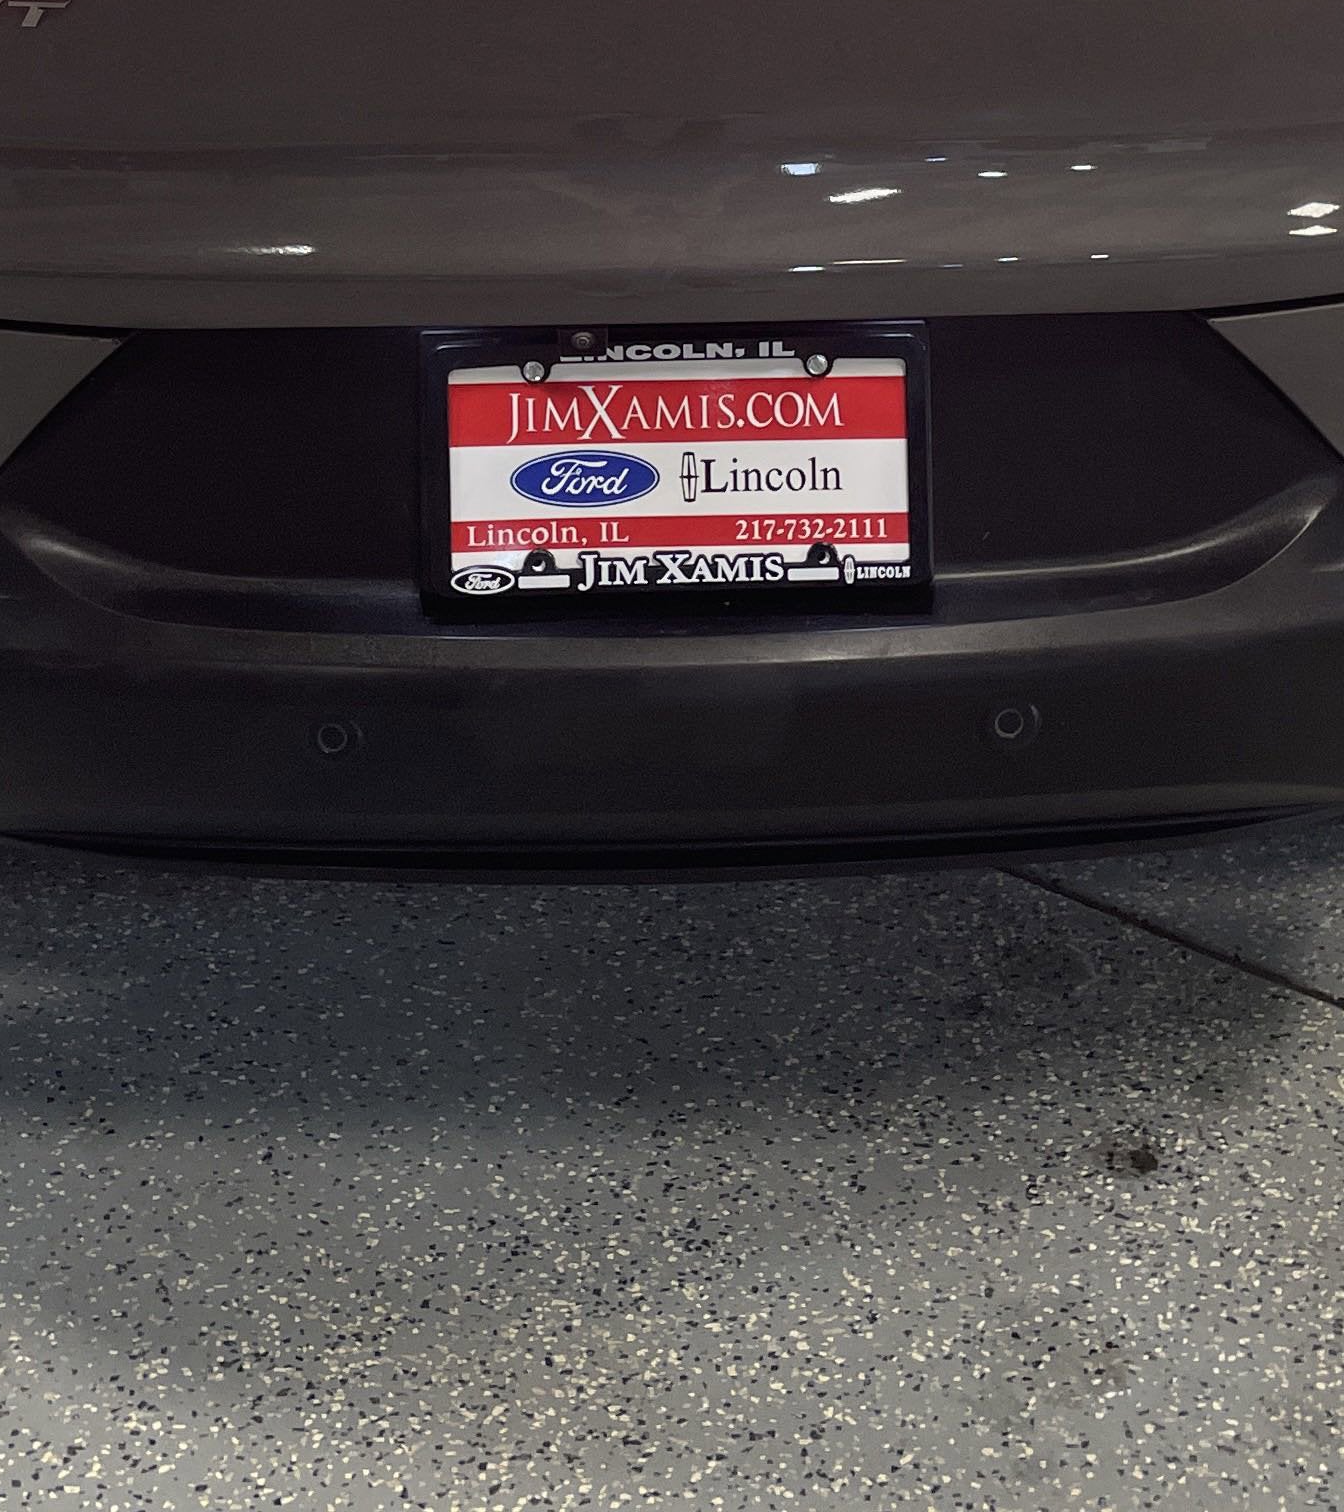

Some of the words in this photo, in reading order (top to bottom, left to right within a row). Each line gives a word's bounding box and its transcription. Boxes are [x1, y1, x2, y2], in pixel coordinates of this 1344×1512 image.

[560, 342, 745, 363] NCOLN,
[759, 341, 795, 357] IL
[507, 385, 844, 443] JIMXAMIS.COM
[541, 458, 628, 495] Ford
[700, 457, 842, 493] Lincoln
[467, 521, 588, 547] Lincoln,
[600, 521, 629, 543] IL
[735, 518, 889, 540] 217-732-2111
[577, 554, 647, 590] JIM
[656, 551, 784, 584] XAMIS
[856, 565, 910, 578] LINCOLN
